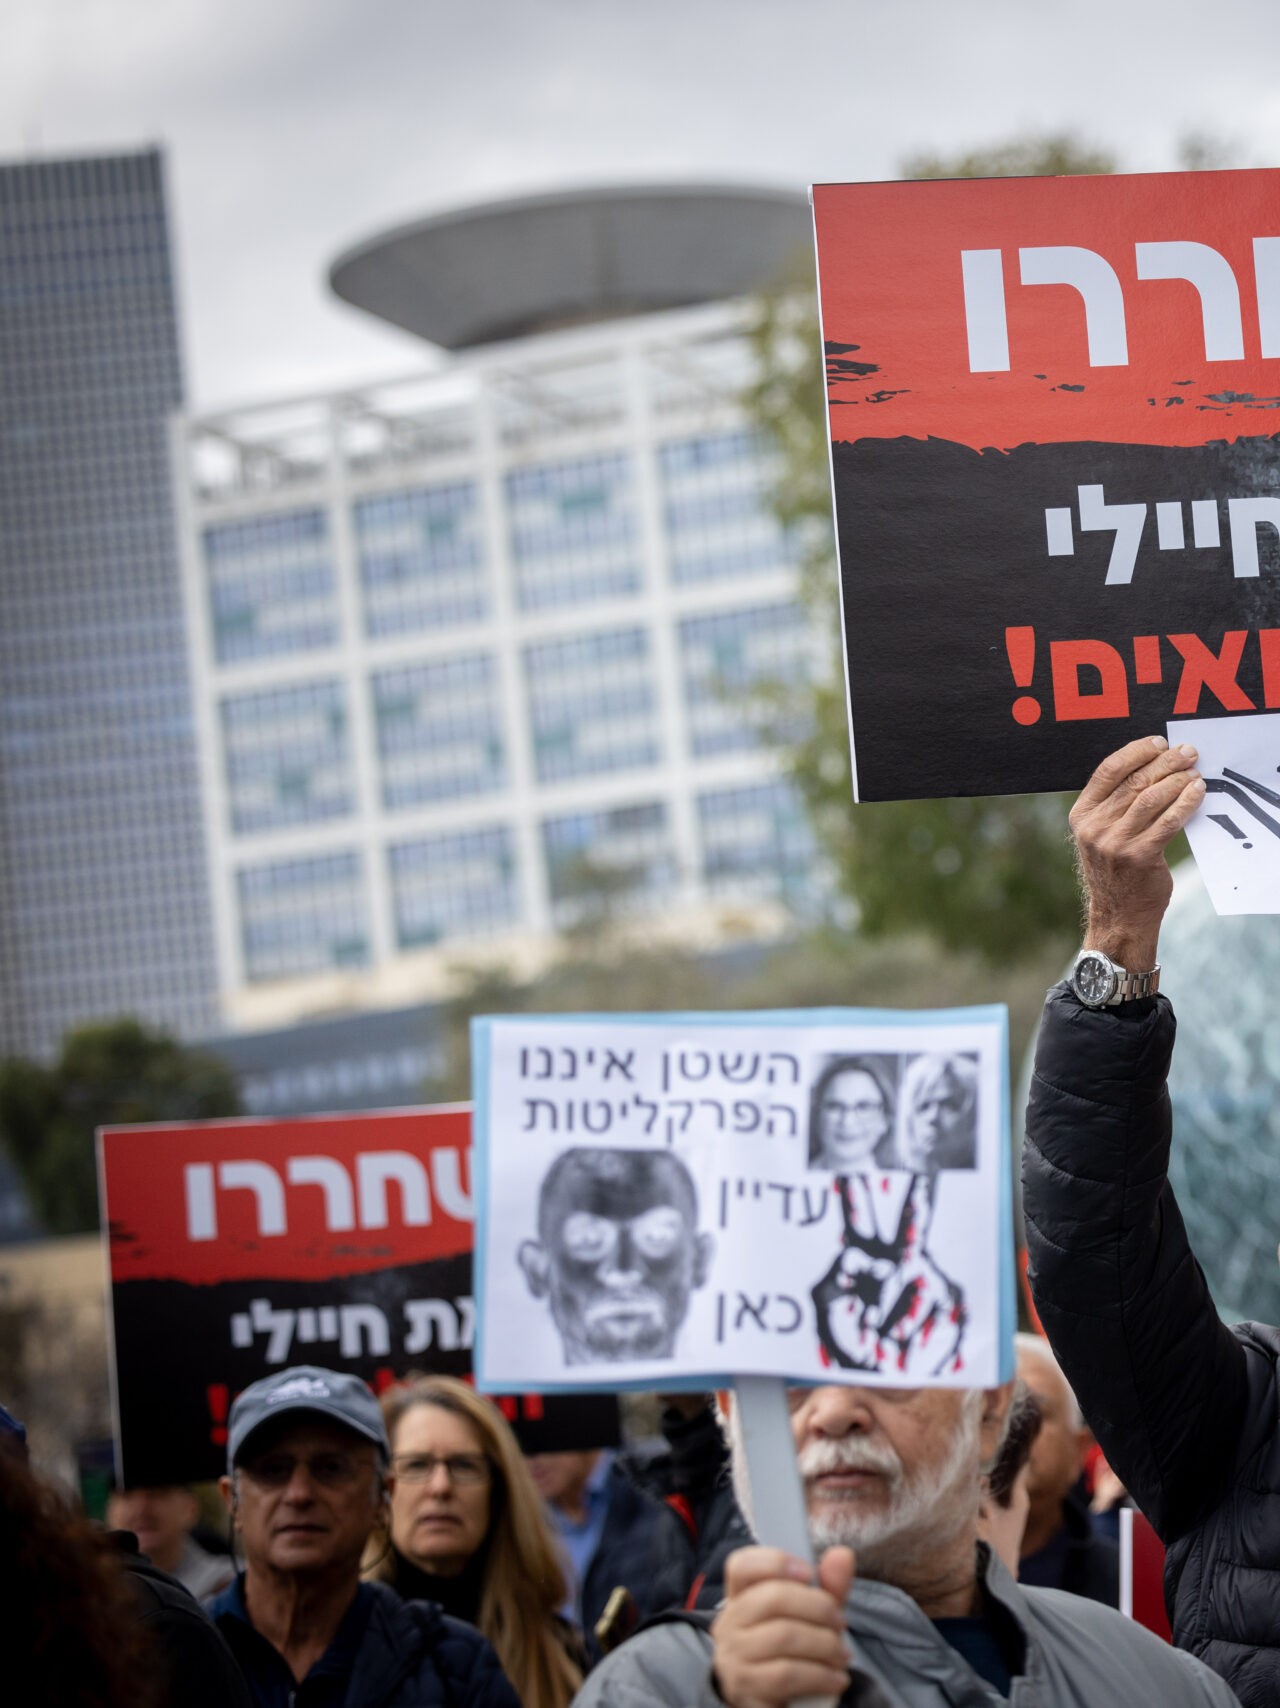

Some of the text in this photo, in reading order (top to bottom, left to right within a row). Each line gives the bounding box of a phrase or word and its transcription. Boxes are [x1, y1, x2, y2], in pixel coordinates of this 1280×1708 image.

[519, 1046, 801, 1093] השטן איננו
[521, 1093, 798, 1144] הפרקליטות
[719, 1178, 830, 1230] עדיין
[231, 1299, 391, 1364] חיילי
[715, 1291, 805, 1343] כאן
